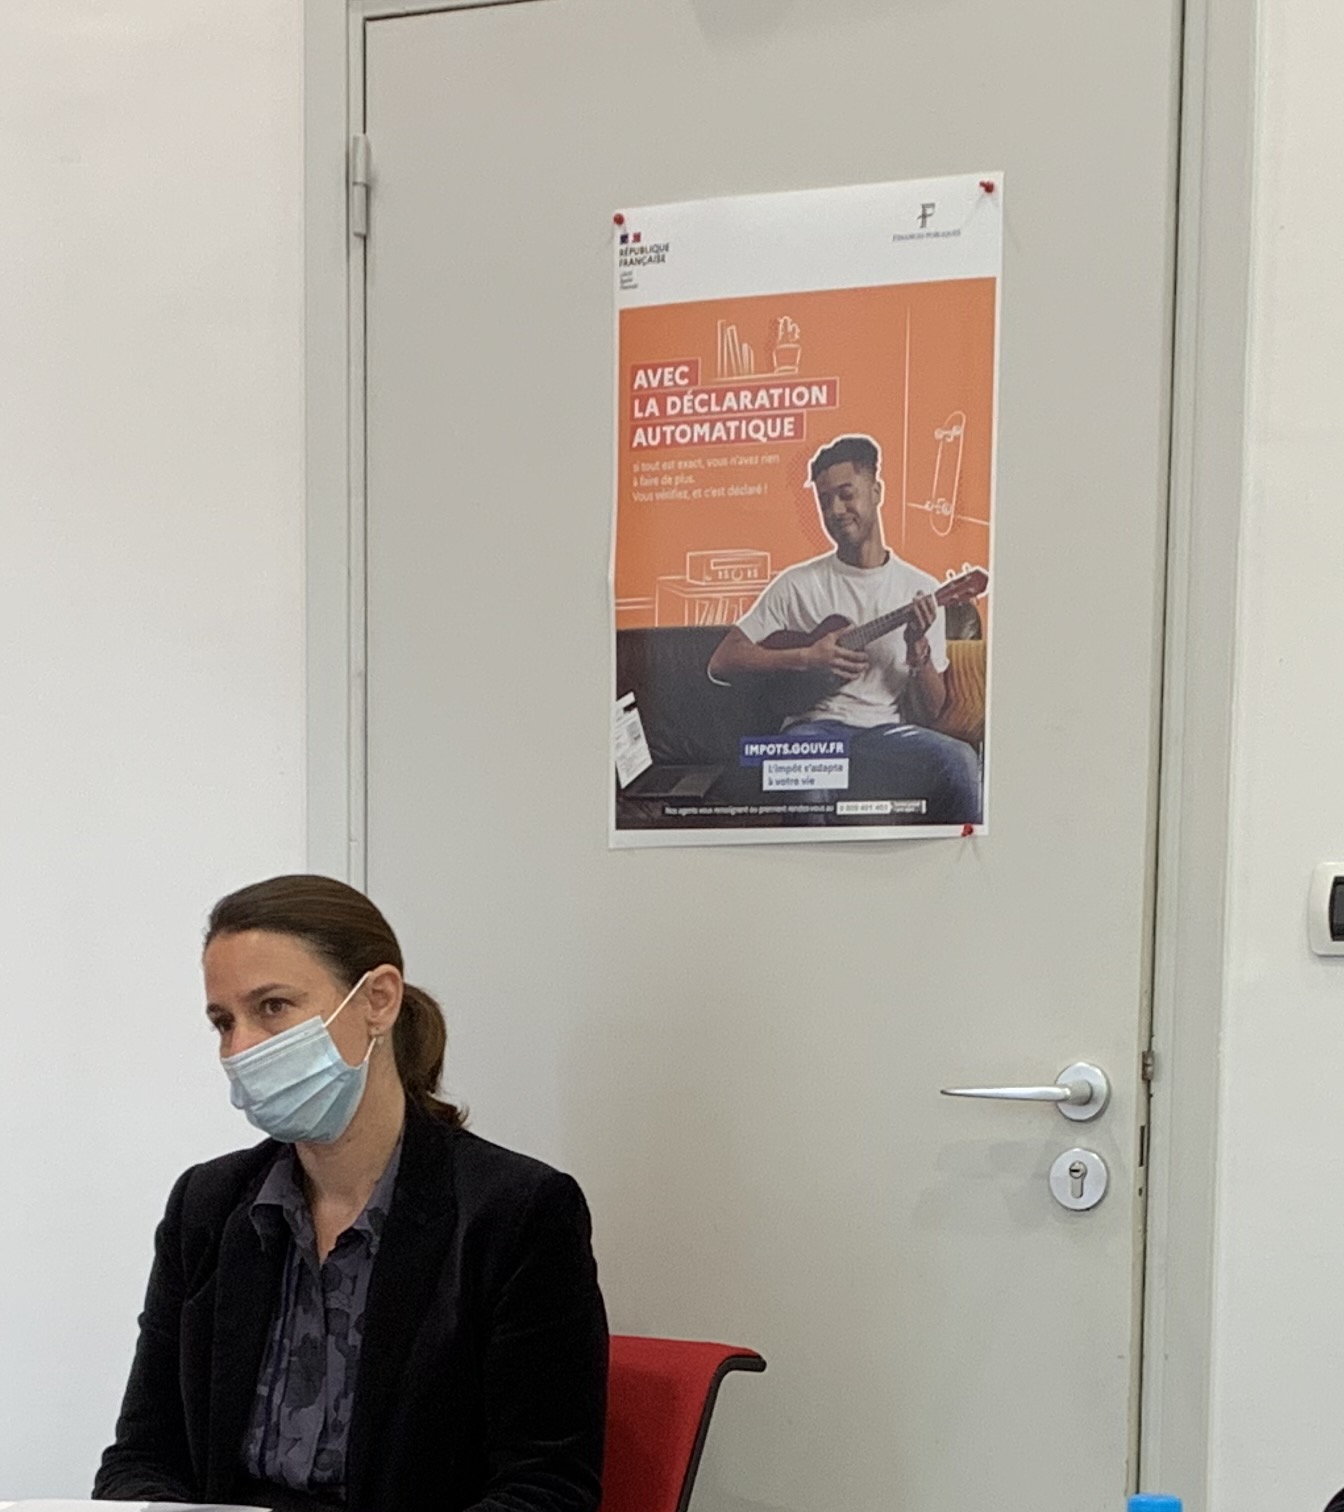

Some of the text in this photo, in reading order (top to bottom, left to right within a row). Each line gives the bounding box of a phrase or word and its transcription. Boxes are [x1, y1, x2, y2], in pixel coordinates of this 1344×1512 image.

[633, 365, 690, 390] AVEC
[633, 384, 828, 419] LA DÉCLARATION
[632, 416, 796, 448] AUTOMATIQUE
[744, 741, 845, 756] IMPOTS.GOUV.FR
